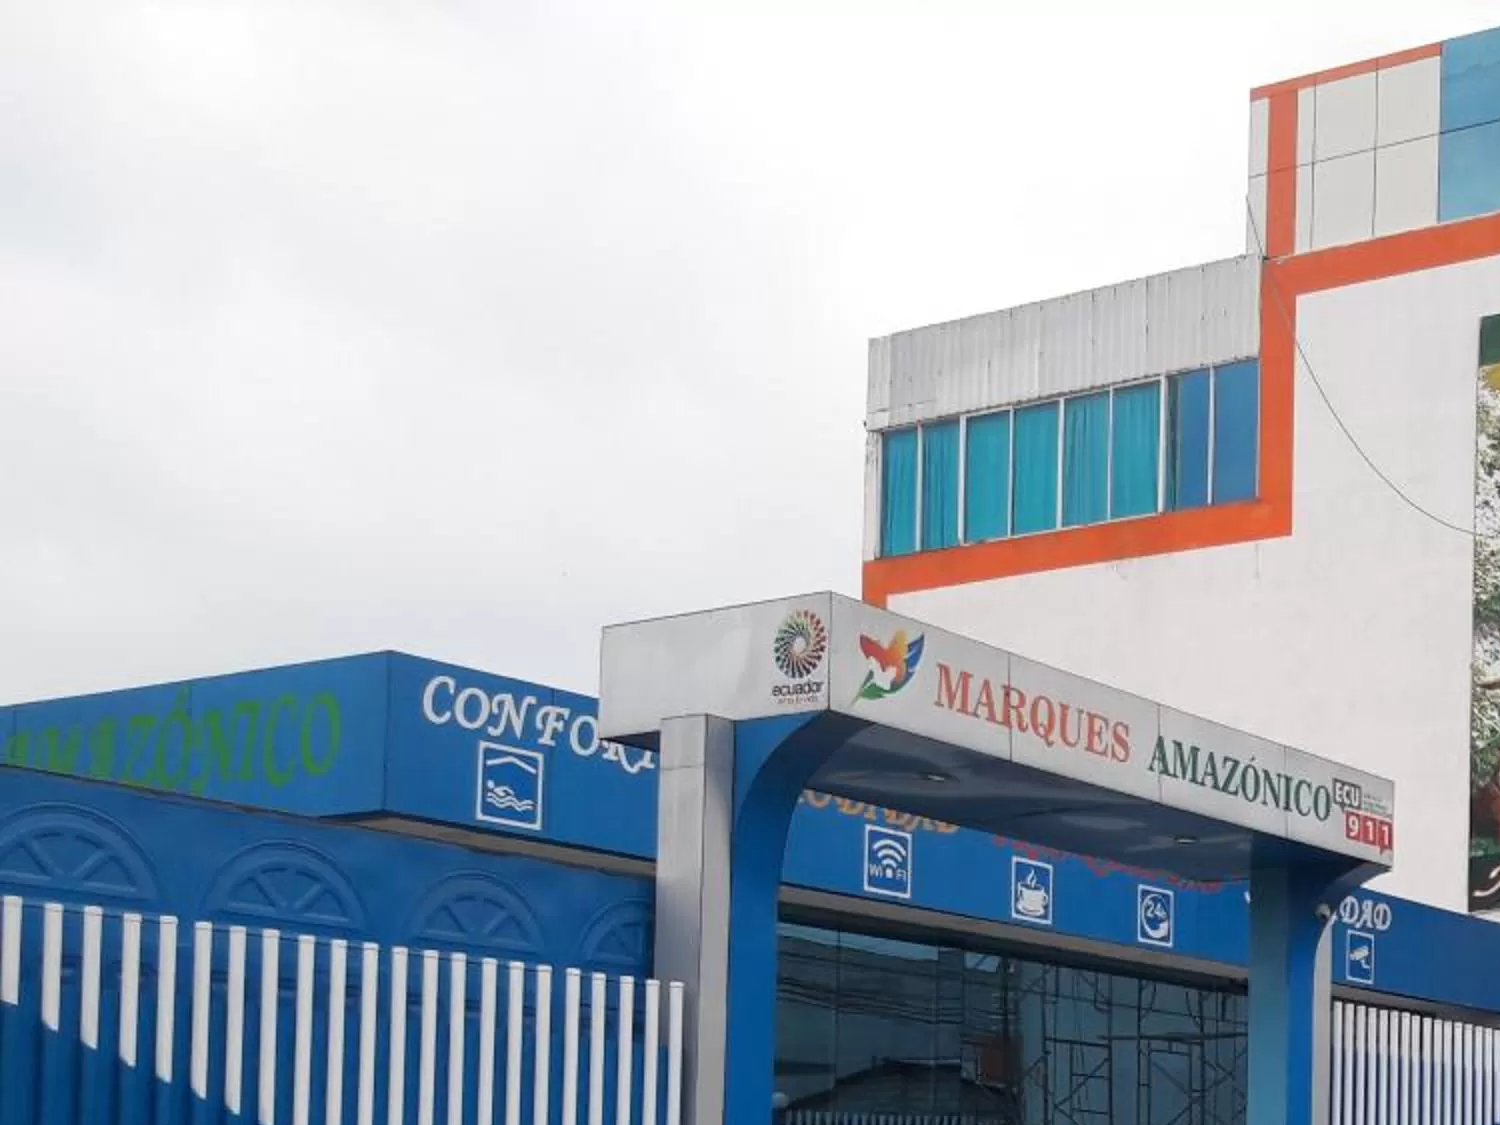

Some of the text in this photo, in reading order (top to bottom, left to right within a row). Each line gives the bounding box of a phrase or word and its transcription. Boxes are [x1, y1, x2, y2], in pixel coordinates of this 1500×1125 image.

[934, 663, 1332, 822] MARQUES AMAZÓNICO
[1335, 781, 1359, 807] ECU
[1348, 815, 1389, 846] 911
